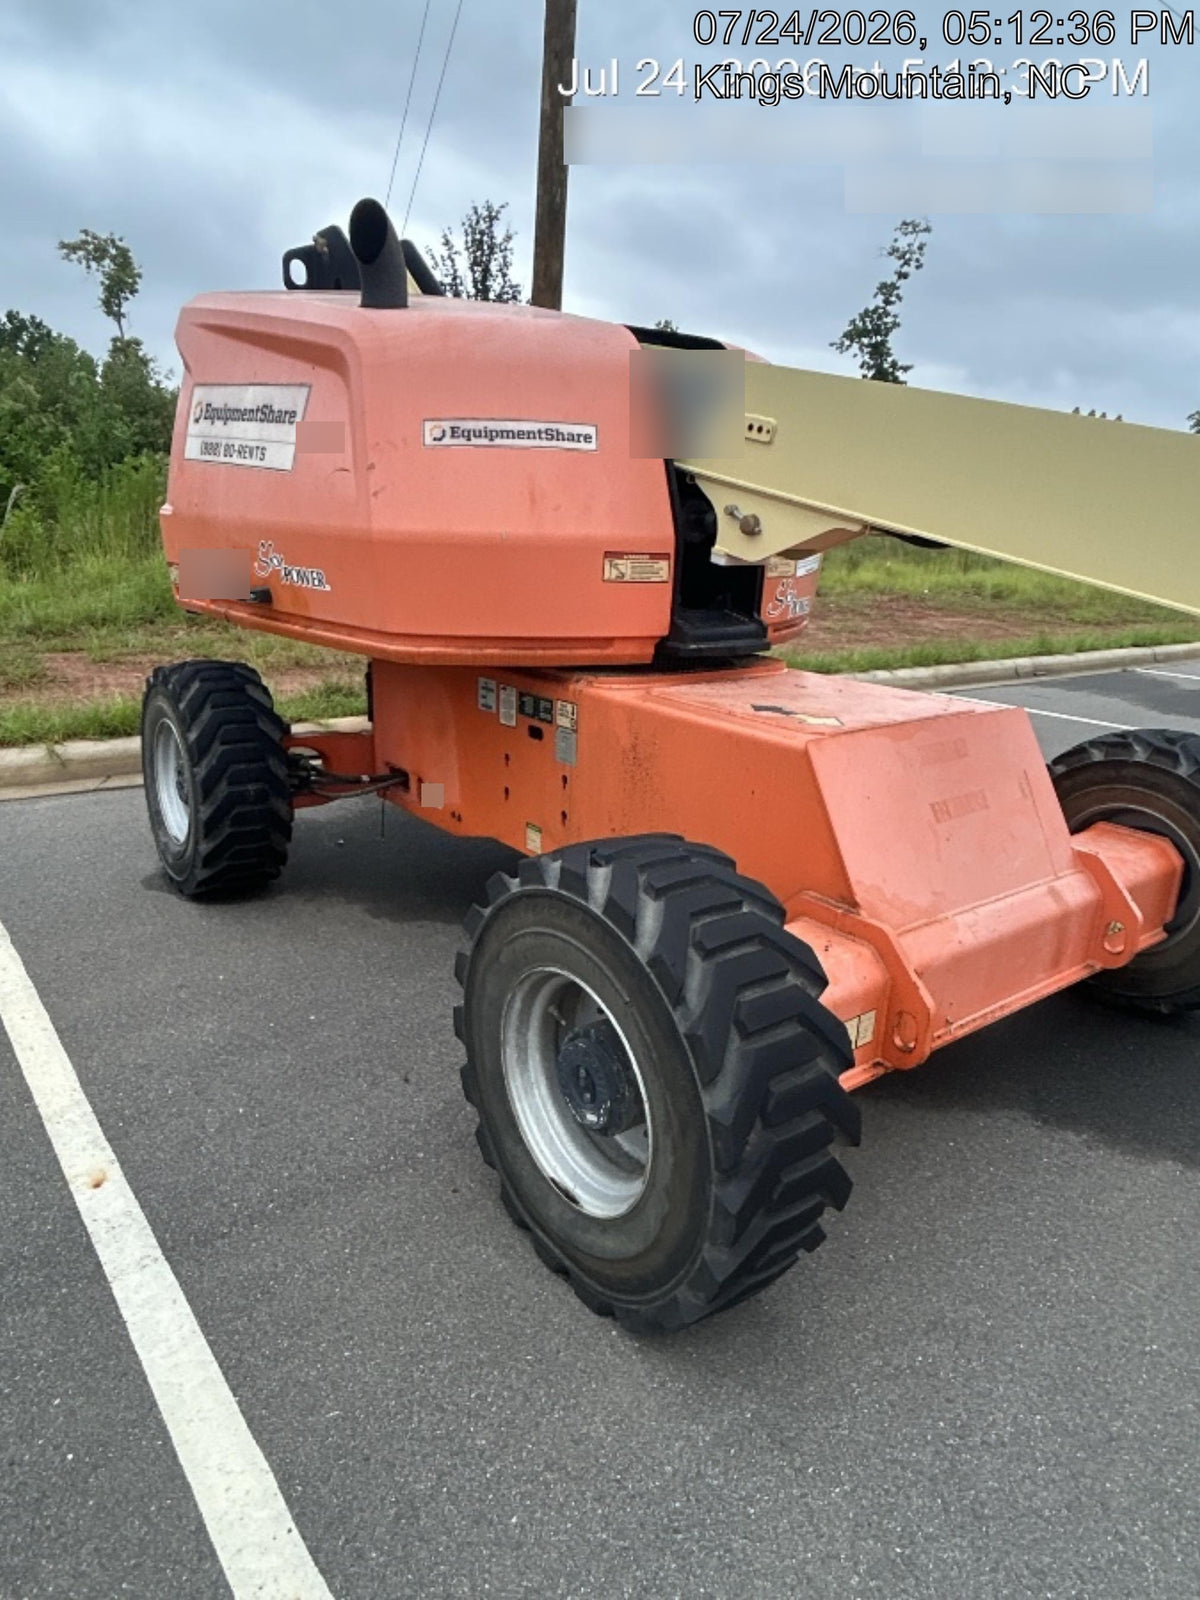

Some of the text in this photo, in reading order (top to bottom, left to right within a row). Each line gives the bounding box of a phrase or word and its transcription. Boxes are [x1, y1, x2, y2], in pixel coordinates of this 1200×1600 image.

[204, 403, 297, 425] EquipmentShare
[449, 426, 593, 444] EquipmentShare
[281, 564, 326, 590] POWER
